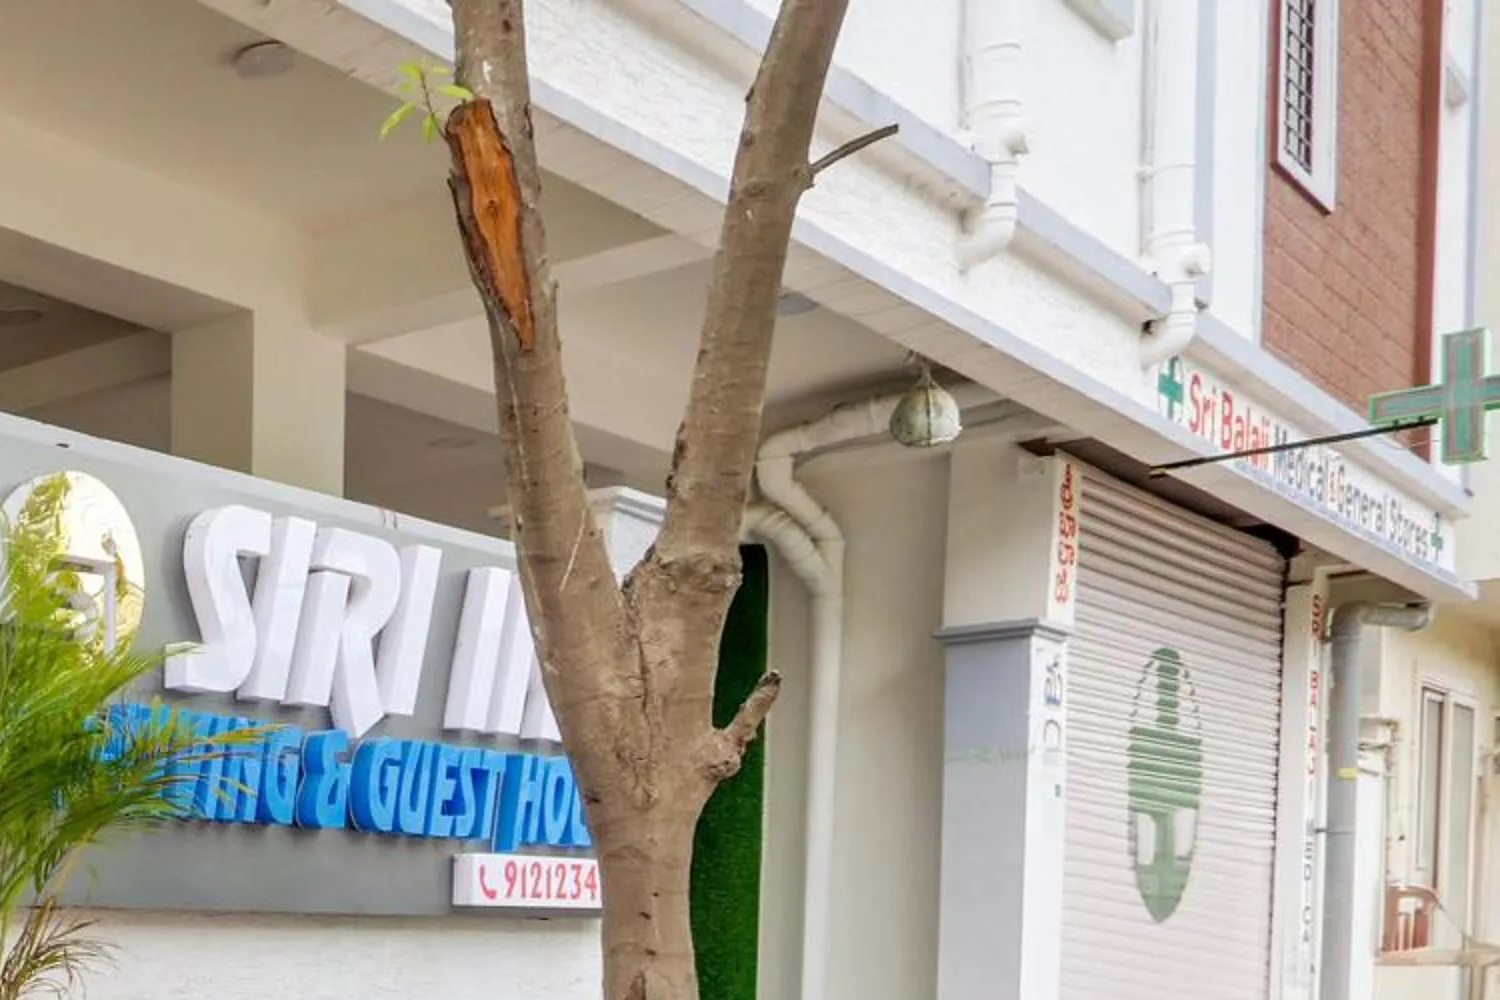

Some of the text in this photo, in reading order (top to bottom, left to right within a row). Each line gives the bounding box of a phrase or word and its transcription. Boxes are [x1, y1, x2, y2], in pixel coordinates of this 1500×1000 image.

[1188, 374, 1216, 441] Sri
[1221, 391, 1270, 471] Balaji
[164, 505, 442, 739] SIRI
[350, 737, 507, 839] GUEST
